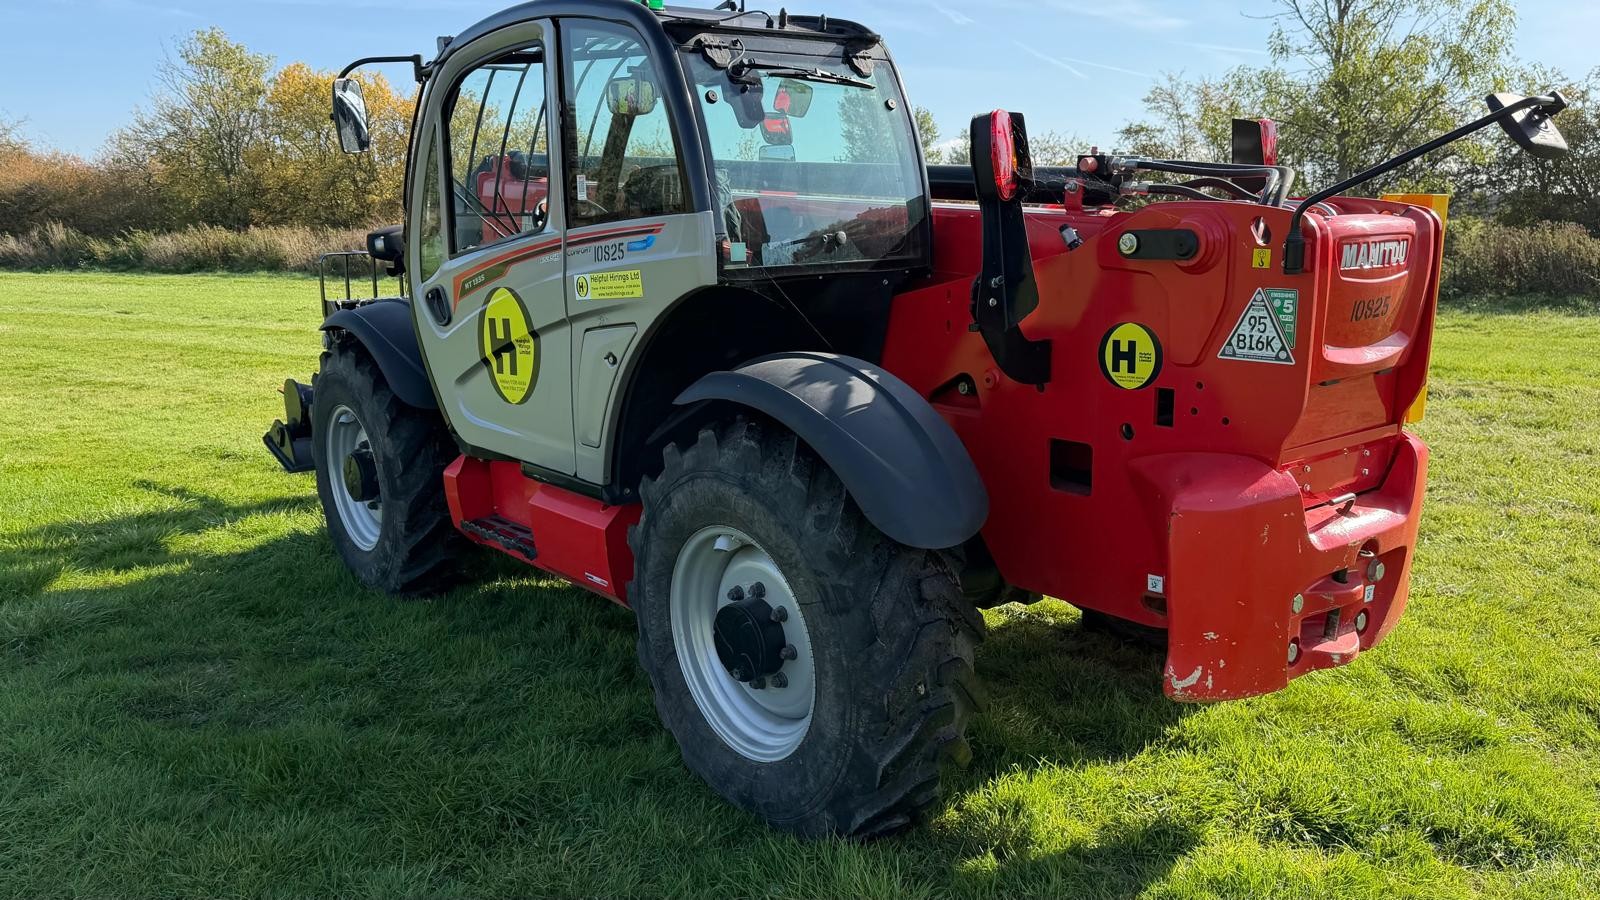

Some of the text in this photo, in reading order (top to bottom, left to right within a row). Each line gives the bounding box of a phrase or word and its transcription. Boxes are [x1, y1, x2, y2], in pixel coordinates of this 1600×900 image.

[1340, 240, 1407, 270] MANITOU
[591, 271, 640, 284] Helpful Hirings Ltd
[578, 281, 585, 293] H
[1282, 299, 1294, 313] 5
[1248, 315, 1267, 333] 95
[488, 317, 518, 376] H
[1112, 340, 1136, 374] H
